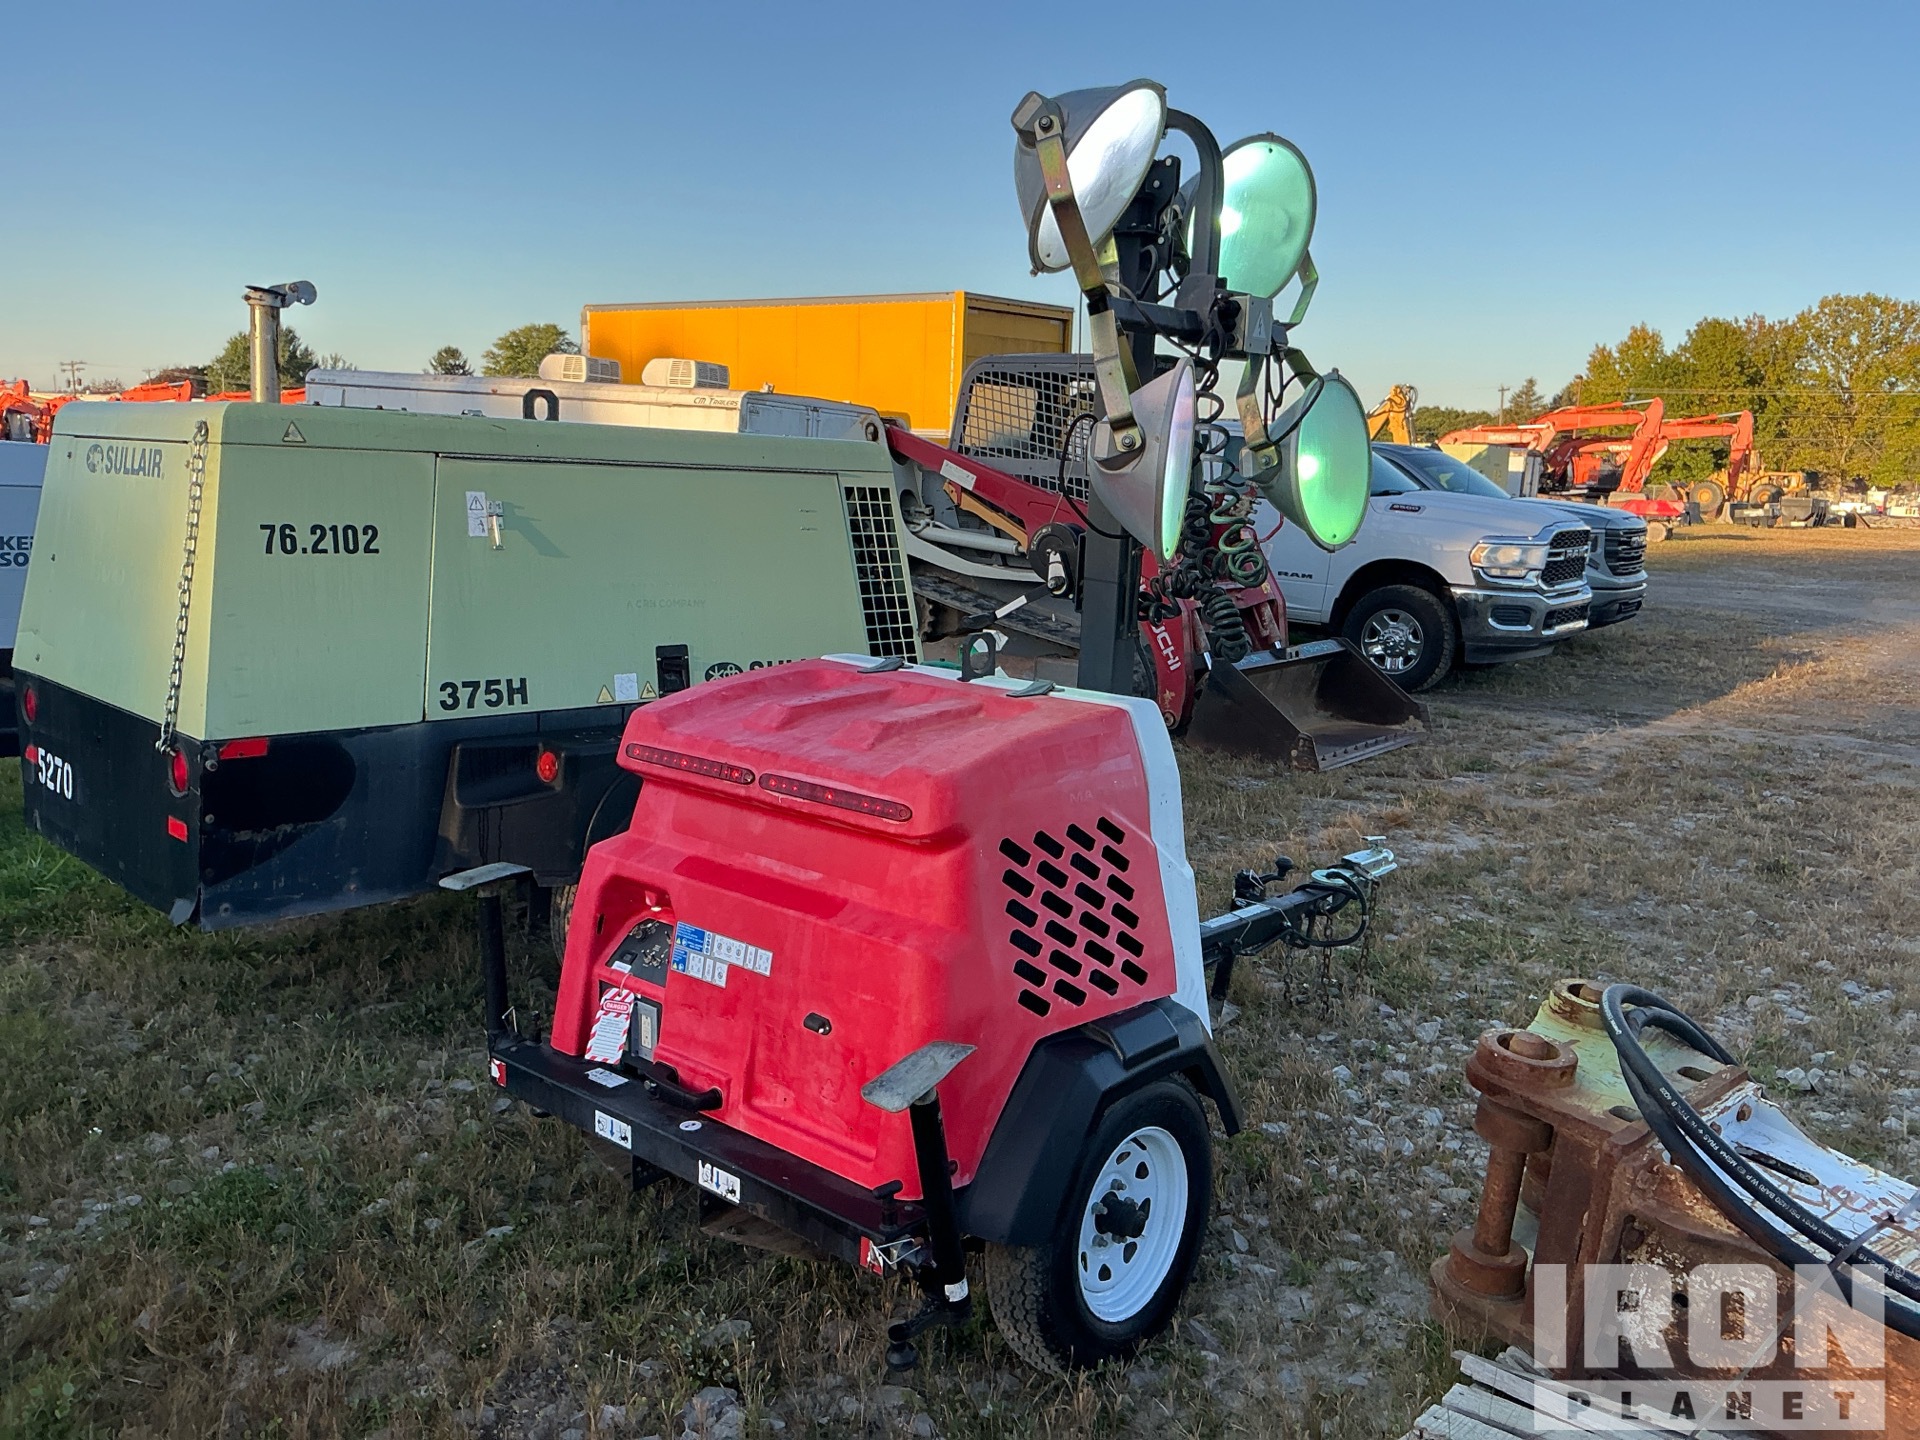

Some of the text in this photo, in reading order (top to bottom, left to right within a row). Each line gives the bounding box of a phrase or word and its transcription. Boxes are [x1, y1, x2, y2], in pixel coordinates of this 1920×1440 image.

[105, 445, 163, 479] SULLAIR
[259, 523, 380, 555] 76.2102
[1277, 570, 1313, 580] RAM
[439, 677, 528, 711] 375H
[37, 746, 73, 800] 5270
[605, 1002, 628, 1011] DANGER
